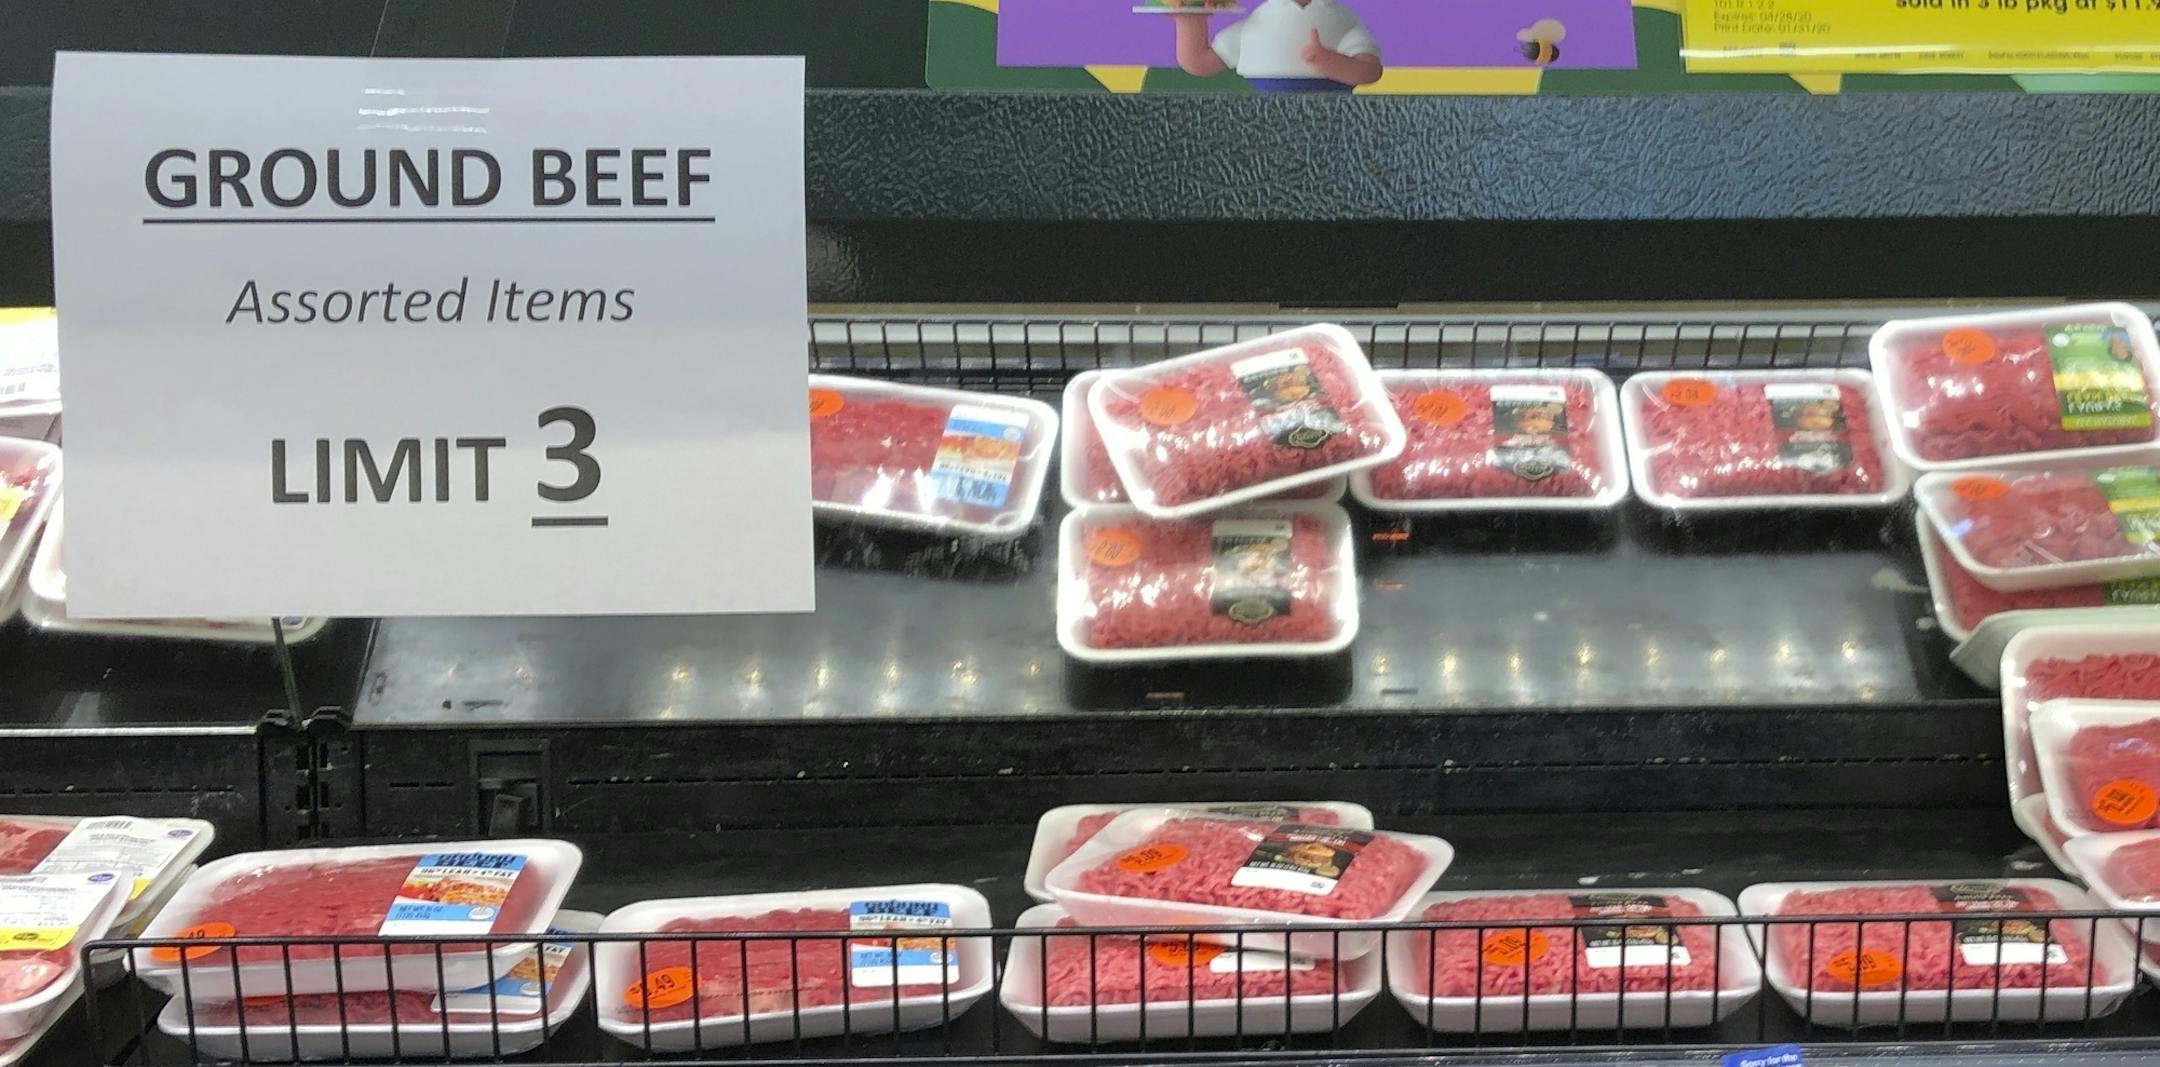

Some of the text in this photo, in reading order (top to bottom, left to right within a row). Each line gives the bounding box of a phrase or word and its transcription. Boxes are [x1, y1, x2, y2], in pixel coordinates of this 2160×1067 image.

[146, 149, 711, 208] GROUND BEEF
[226, 277, 635, 323] Assorted Items
[271, 406, 601, 504] LIMIT 3
